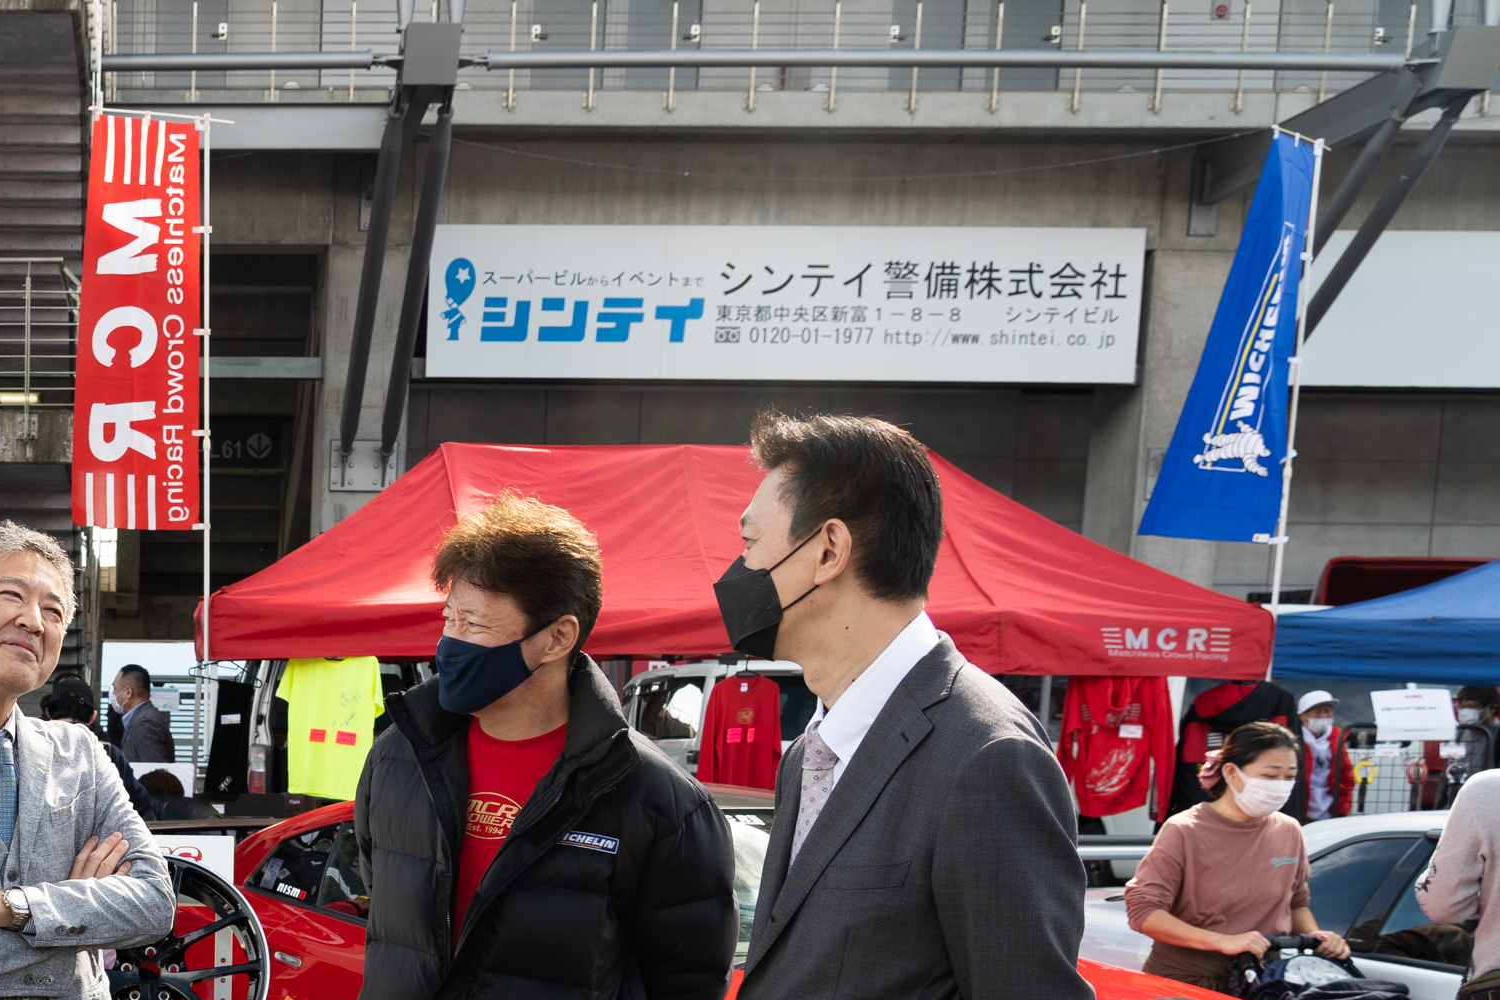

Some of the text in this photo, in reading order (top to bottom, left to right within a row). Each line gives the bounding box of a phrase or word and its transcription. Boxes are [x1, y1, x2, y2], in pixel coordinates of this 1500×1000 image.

[482, 269, 705, 287] スーパービルからイベントまで
[718, 260, 1128, 300] シンテイ警備株式会社
[480, 297, 706, 343] シンテイ
[1004, 306, 1120, 325] シンテイビル
[749, 327, 874, 346] 0120-01-1977
[1125, 627, 1209, 651] MCR
[484, 825, 504, 836] 1994
[562, 832, 616, 850] ICHELIN
